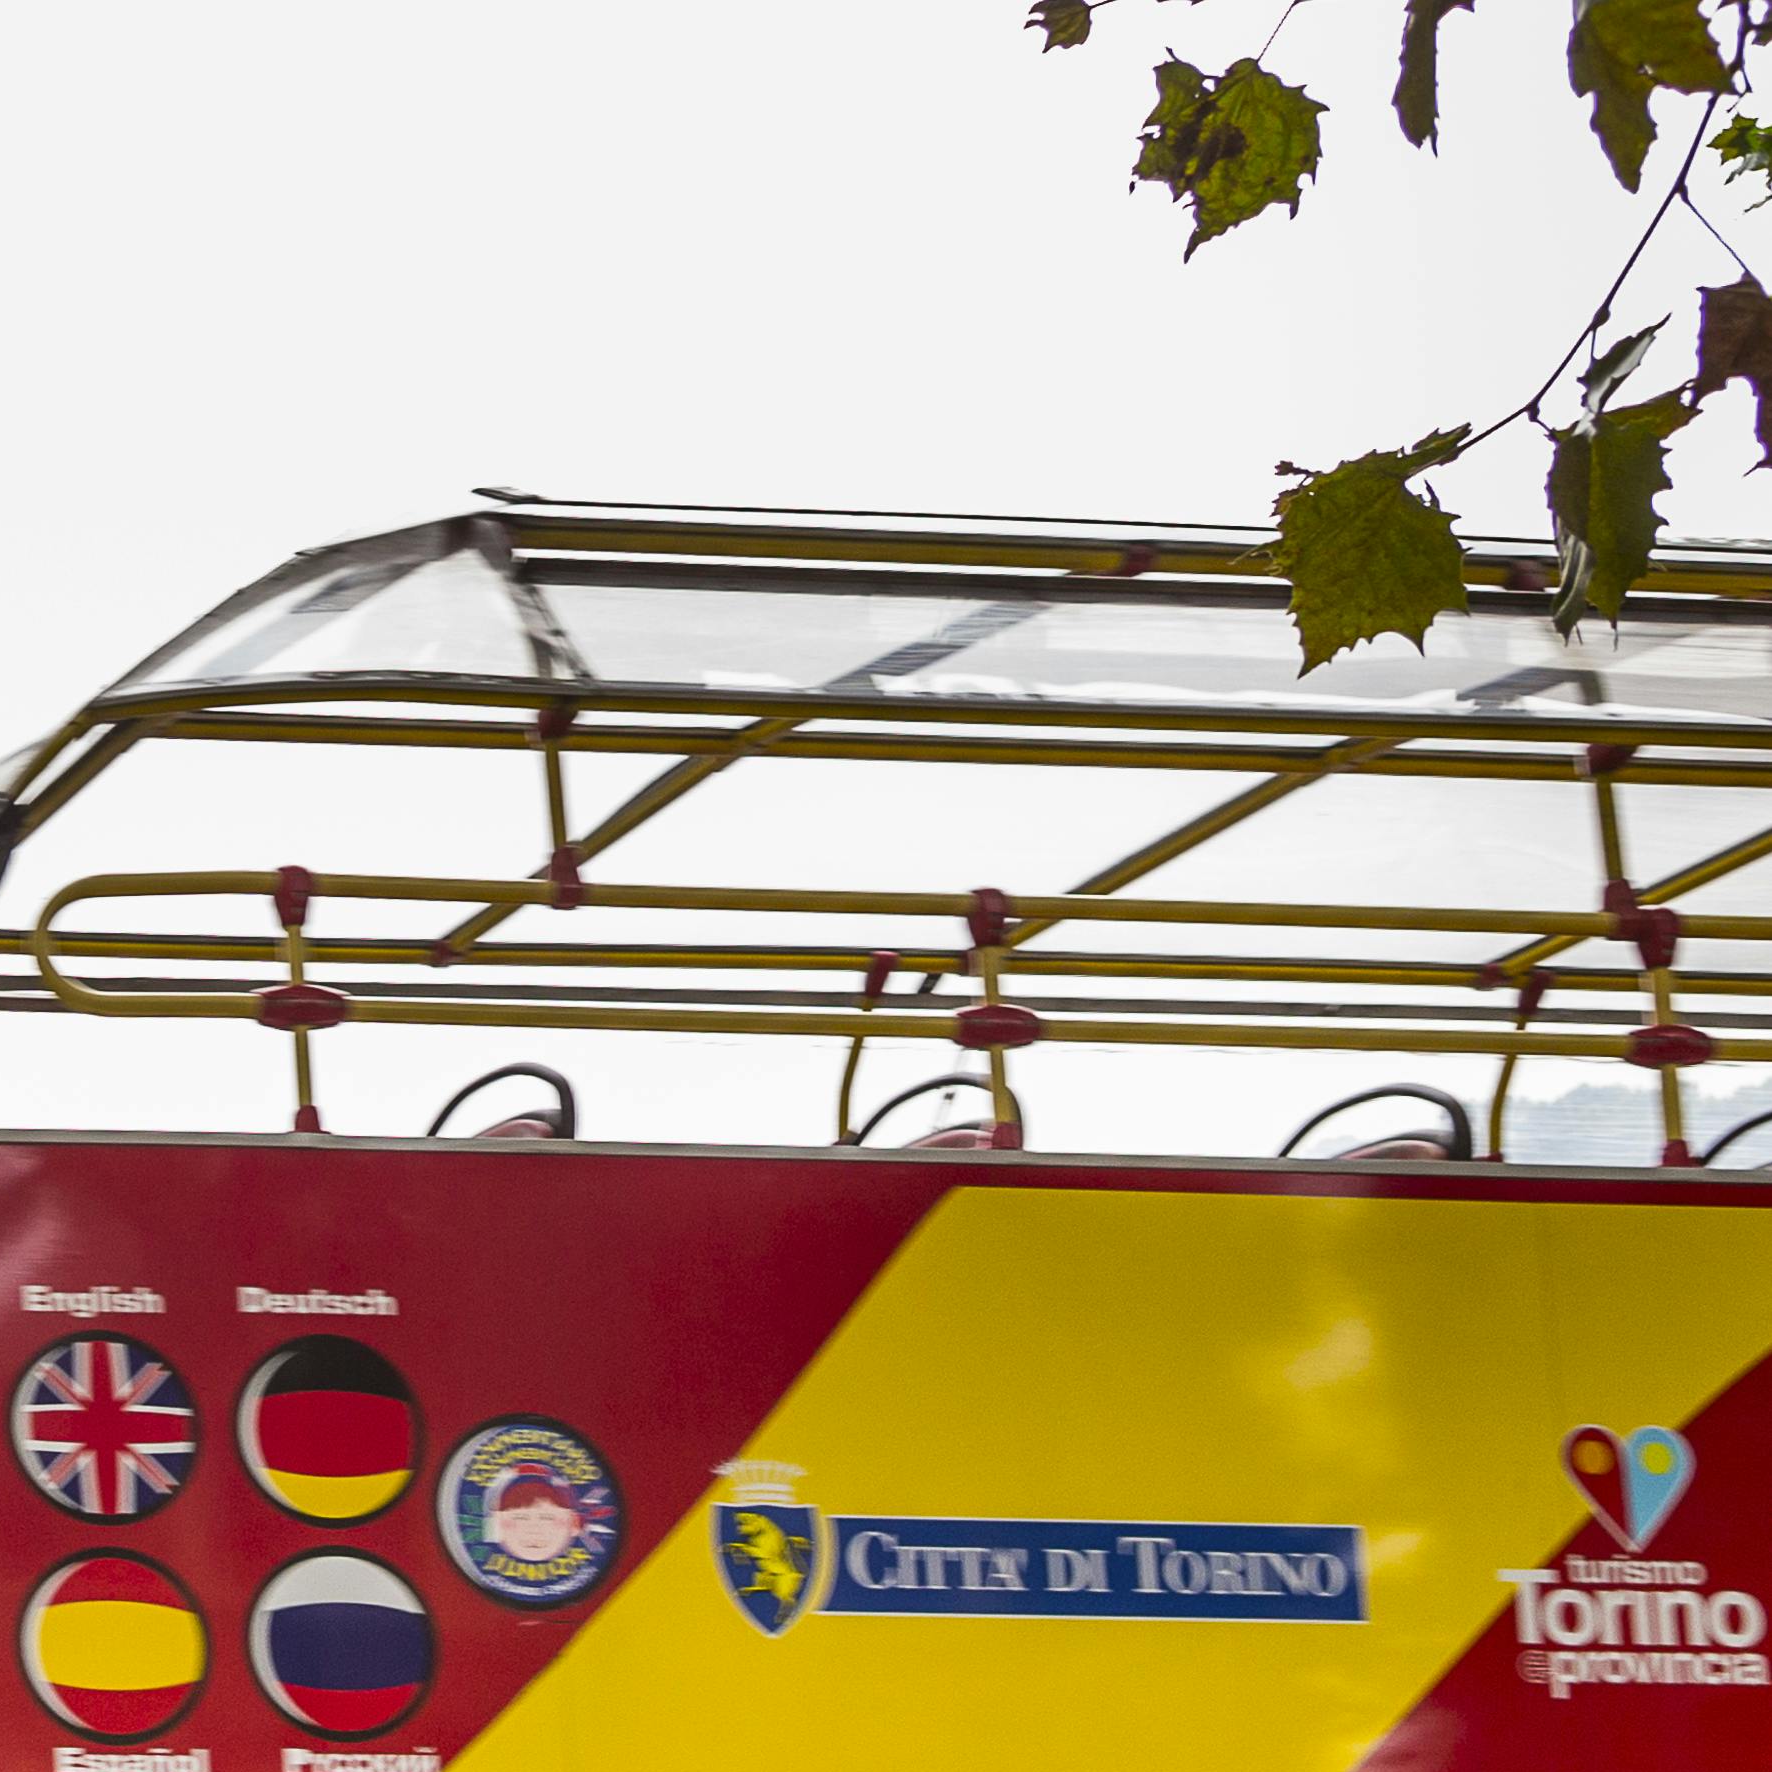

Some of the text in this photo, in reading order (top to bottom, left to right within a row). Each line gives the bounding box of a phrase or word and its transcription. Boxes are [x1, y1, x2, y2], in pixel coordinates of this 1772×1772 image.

[19, 1285, 167, 1318] English
[236, 1286, 400, 1316] Deutsch
[1116, 1536, 1349, 1598] TORINO
[1564, 1553, 1708, 1585] turismo
[1496, 1568, 1768, 1648] Torino
